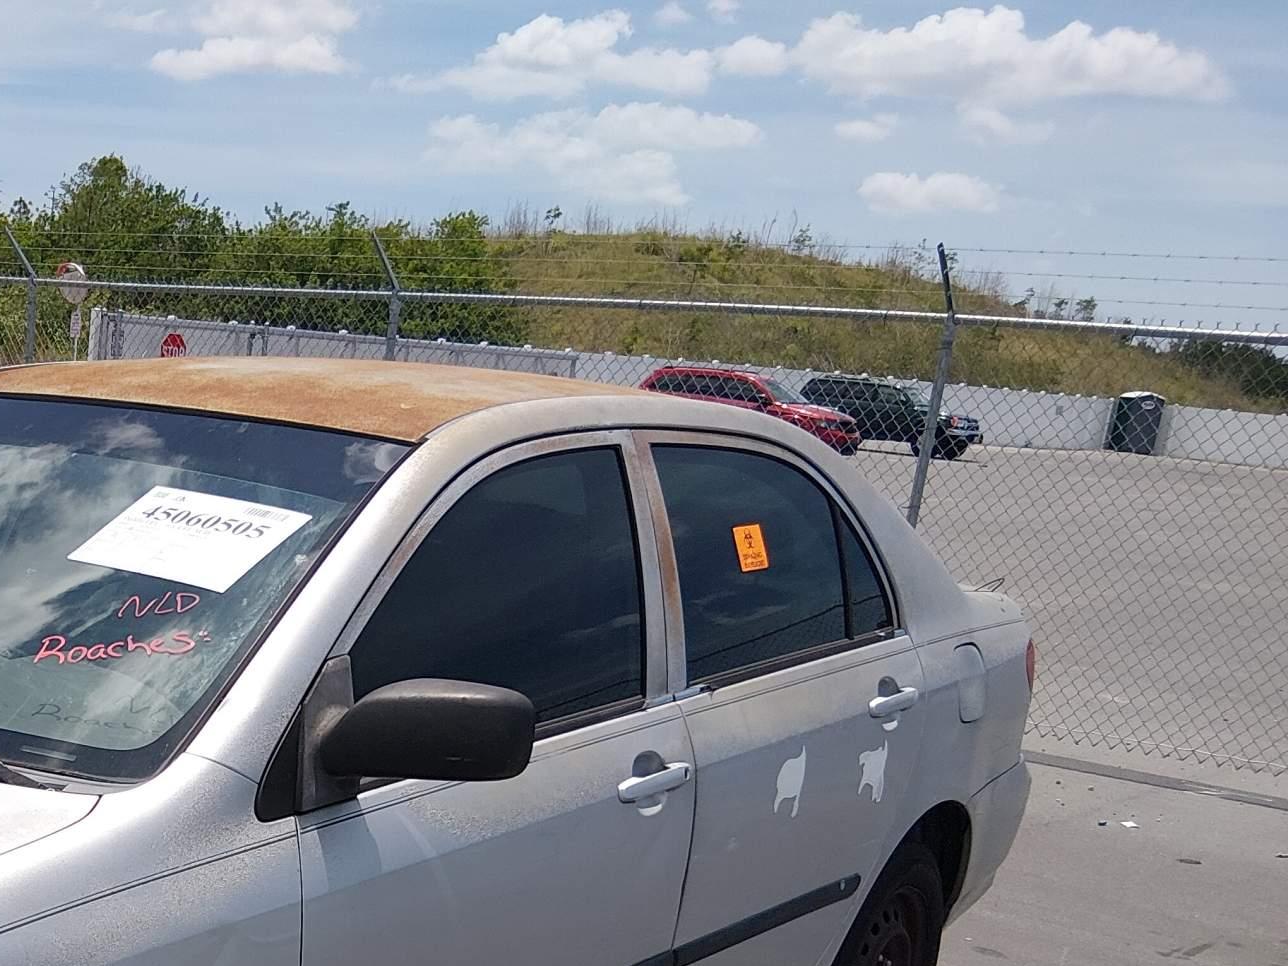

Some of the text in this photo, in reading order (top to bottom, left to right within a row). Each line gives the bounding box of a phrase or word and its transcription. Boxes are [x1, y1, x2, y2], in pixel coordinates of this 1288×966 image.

[161, 346, 185, 357] STOP
[142, 505, 272, 539] 45060505
[117, 591, 200, 618] NLD
